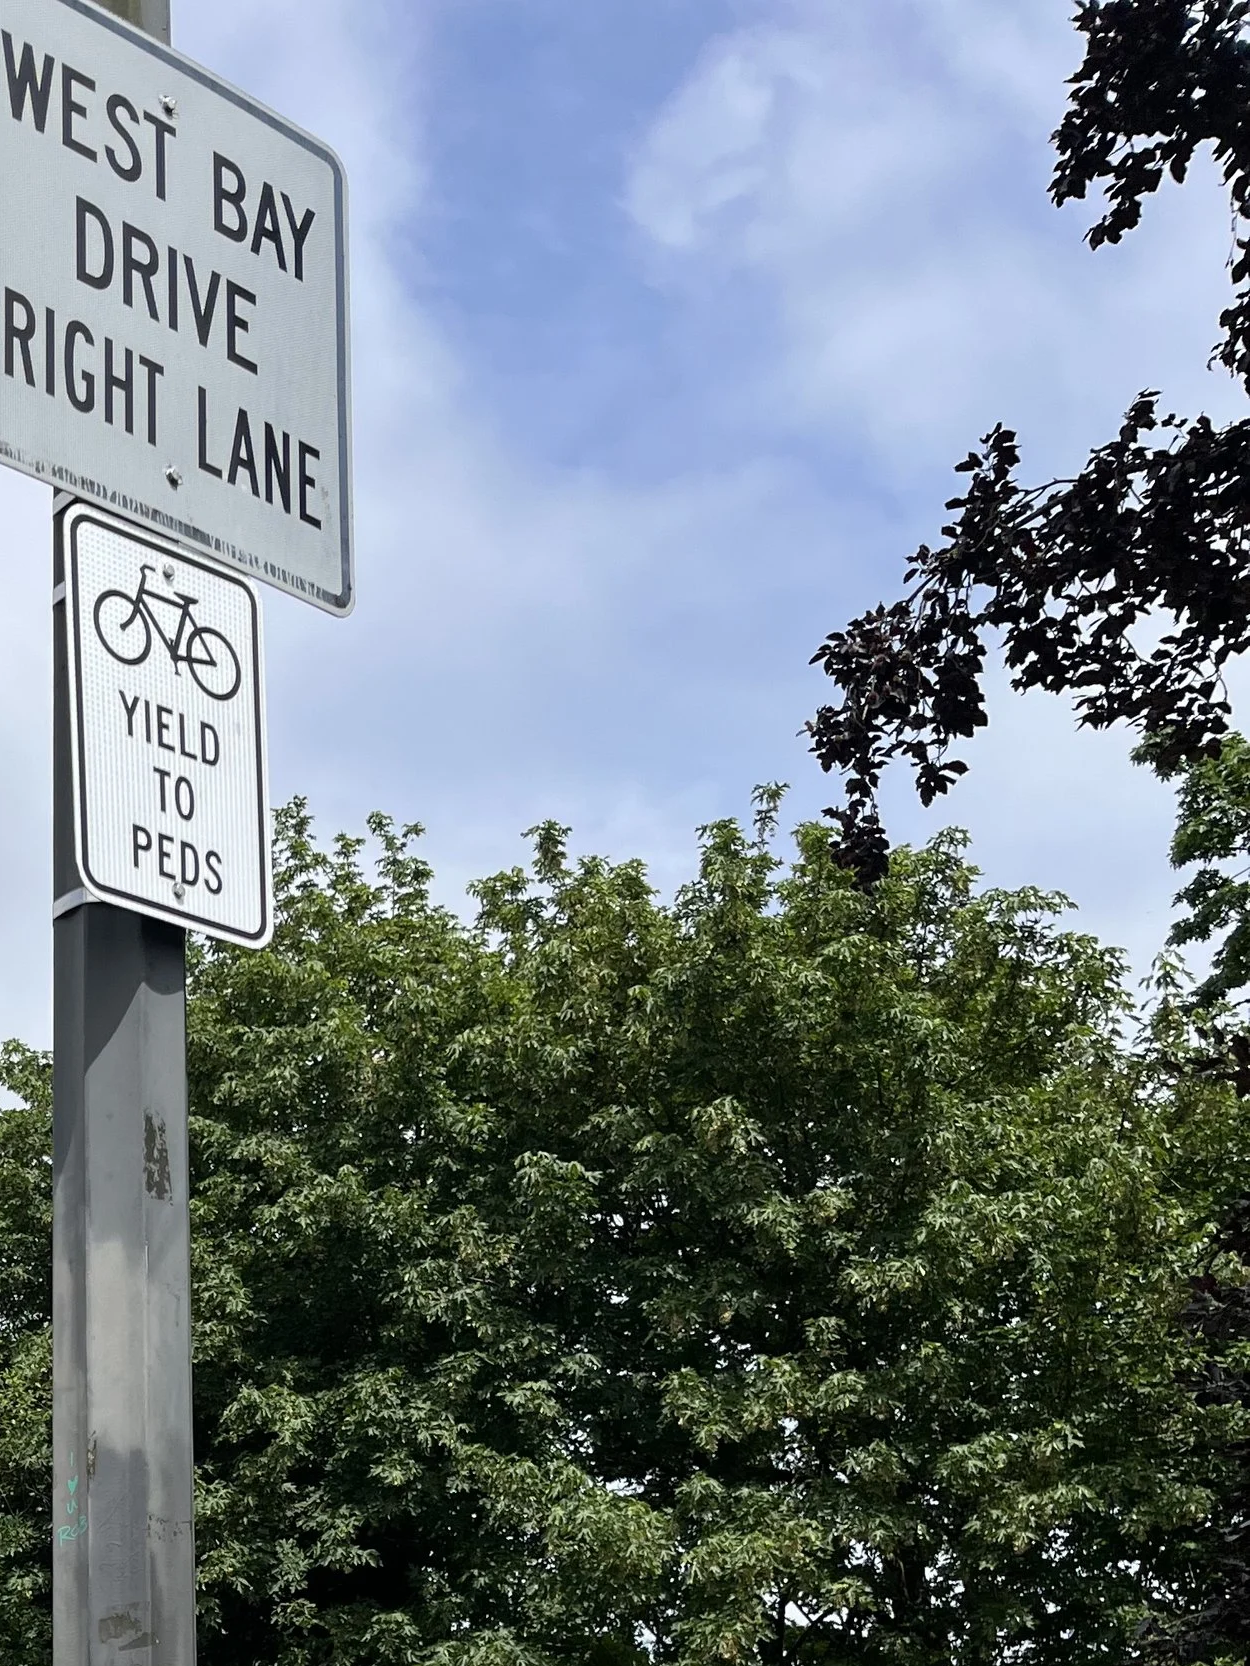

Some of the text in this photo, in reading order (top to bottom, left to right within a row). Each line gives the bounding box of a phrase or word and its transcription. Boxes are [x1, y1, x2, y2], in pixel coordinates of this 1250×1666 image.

[1, 29, 316, 281] WEST BAY
[76, 195, 258, 376] DRIVE
[4, 286, 322, 531] RIGHT LANE
[118, 689, 220, 767] YIELD
[153, 766, 194, 821] TO
[132, 823, 223, 895] PEDS
